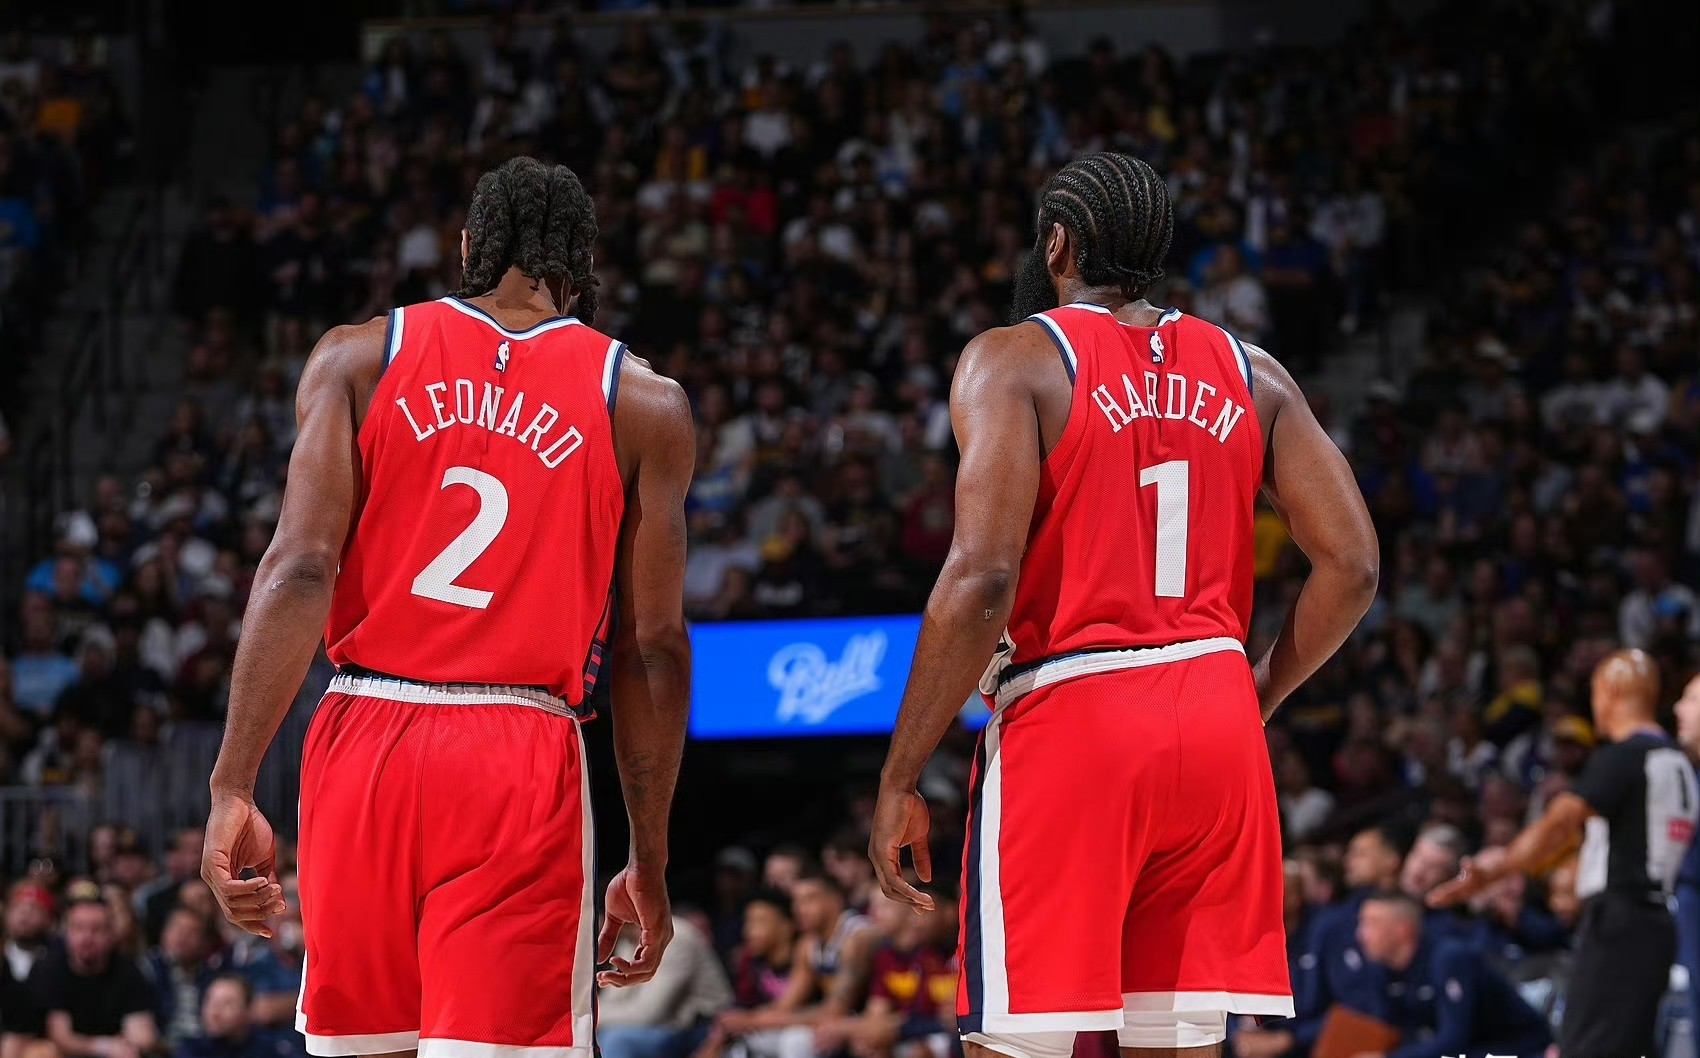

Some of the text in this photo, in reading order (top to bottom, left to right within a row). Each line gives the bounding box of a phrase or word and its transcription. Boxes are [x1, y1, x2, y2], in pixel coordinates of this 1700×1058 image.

[395, 378, 584, 469] LEONARD
[1091, 370, 1246, 444] HARDEN
[410, 465, 509, 609] 2
[1139, 459, 1189, 598] 1
